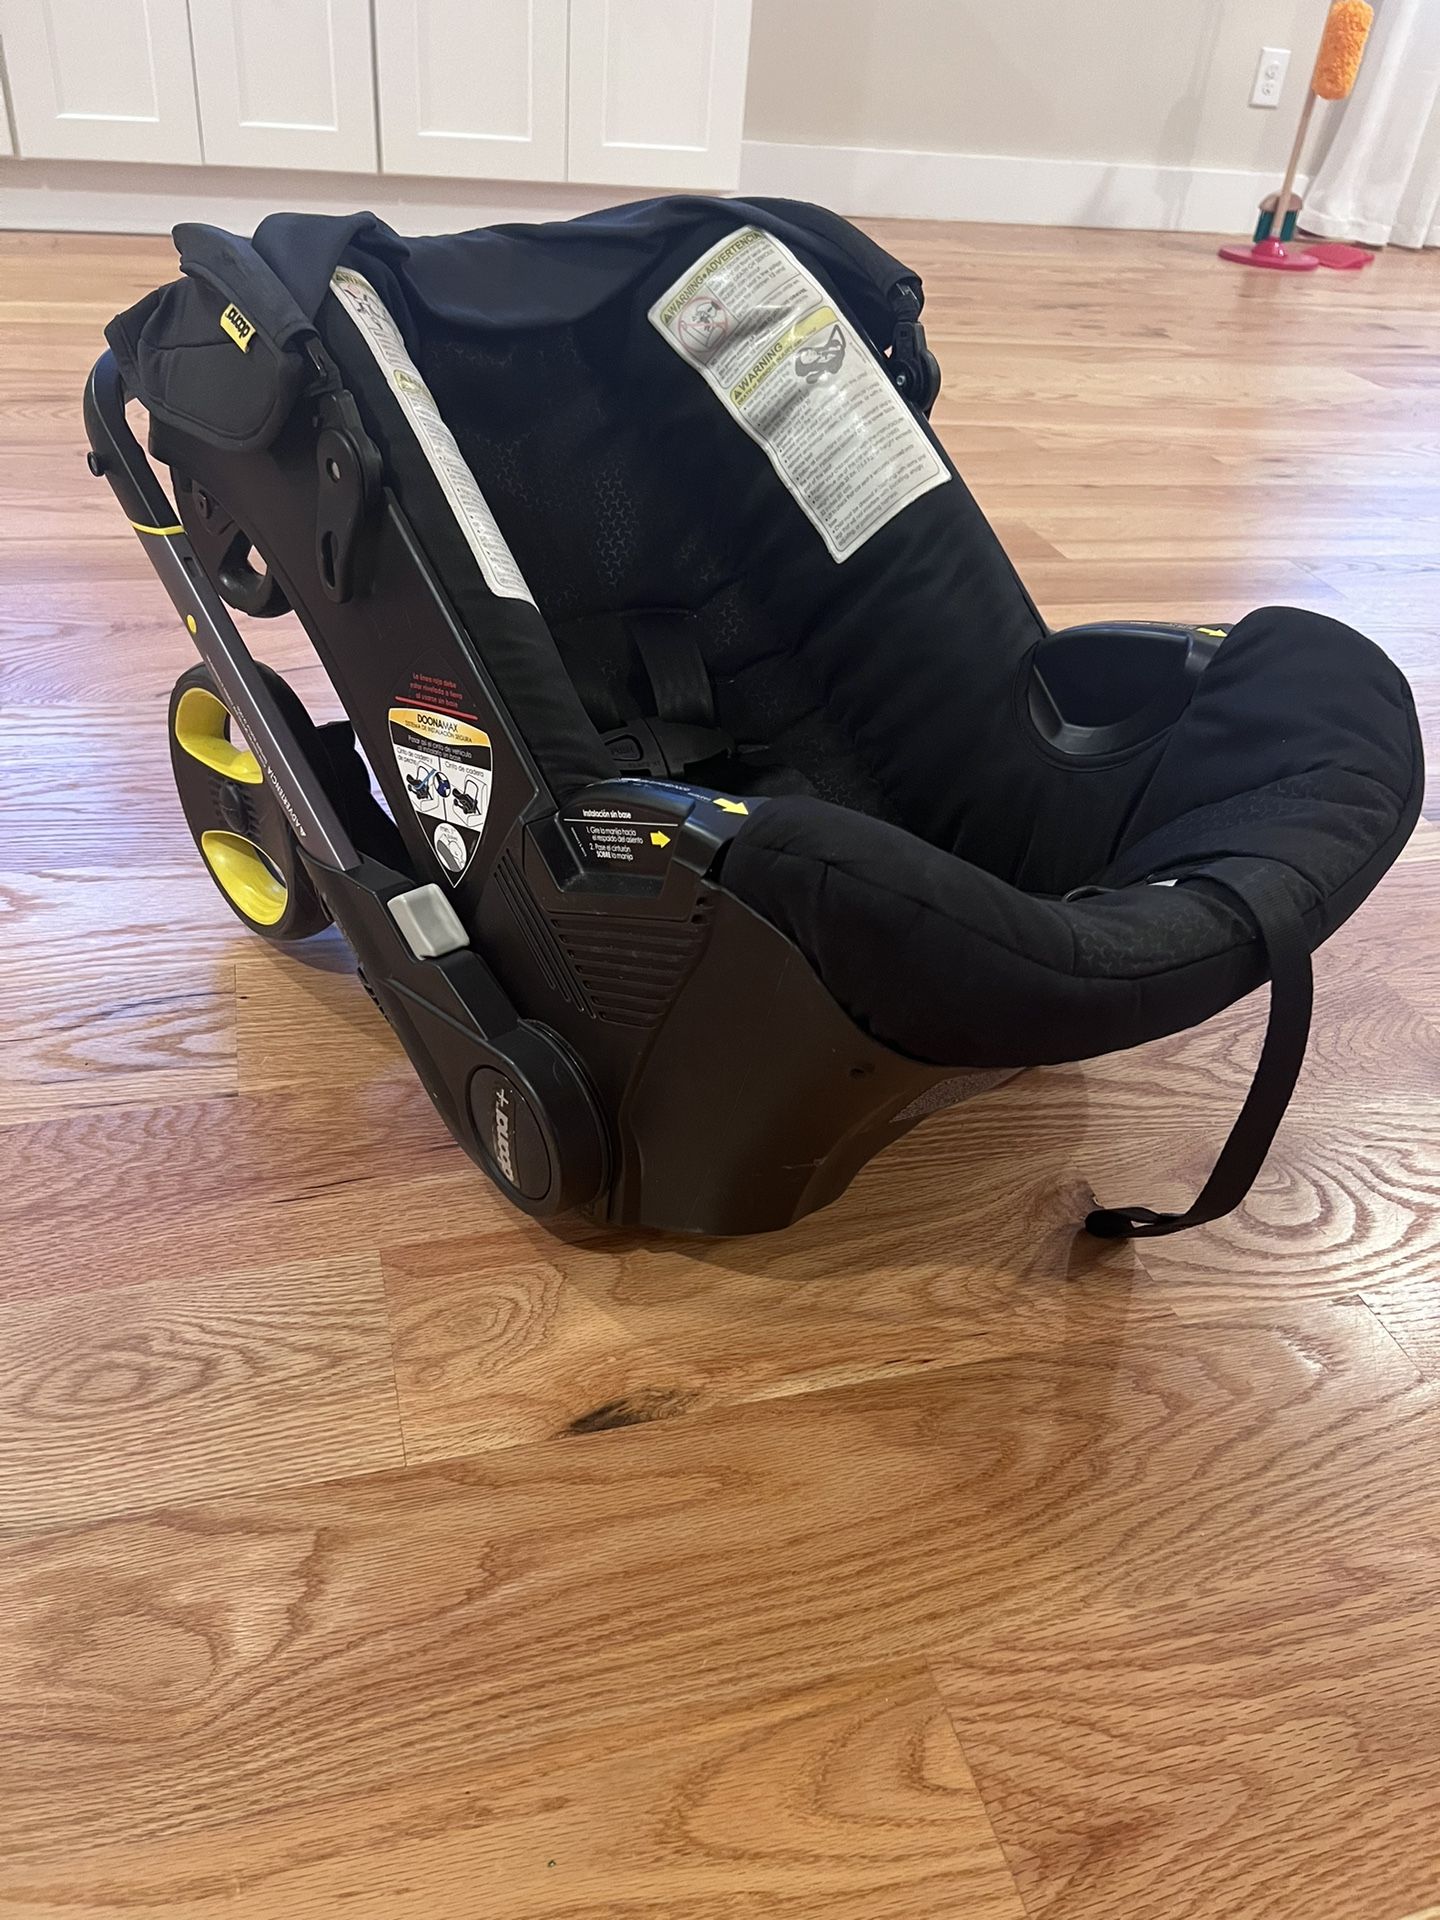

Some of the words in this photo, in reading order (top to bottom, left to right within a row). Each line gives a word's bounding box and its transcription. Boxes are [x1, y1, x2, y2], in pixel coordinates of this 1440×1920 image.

[225, 307, 251, 339] doona
[739, 342, 783, 390] WARNING
[417, 713, 459, 733] DOONAMAX
[267, 765, 301, 827] ADVERTENCIA
[582, 808, 610, 818] Instalación
[618, 810, 632, 819] base
